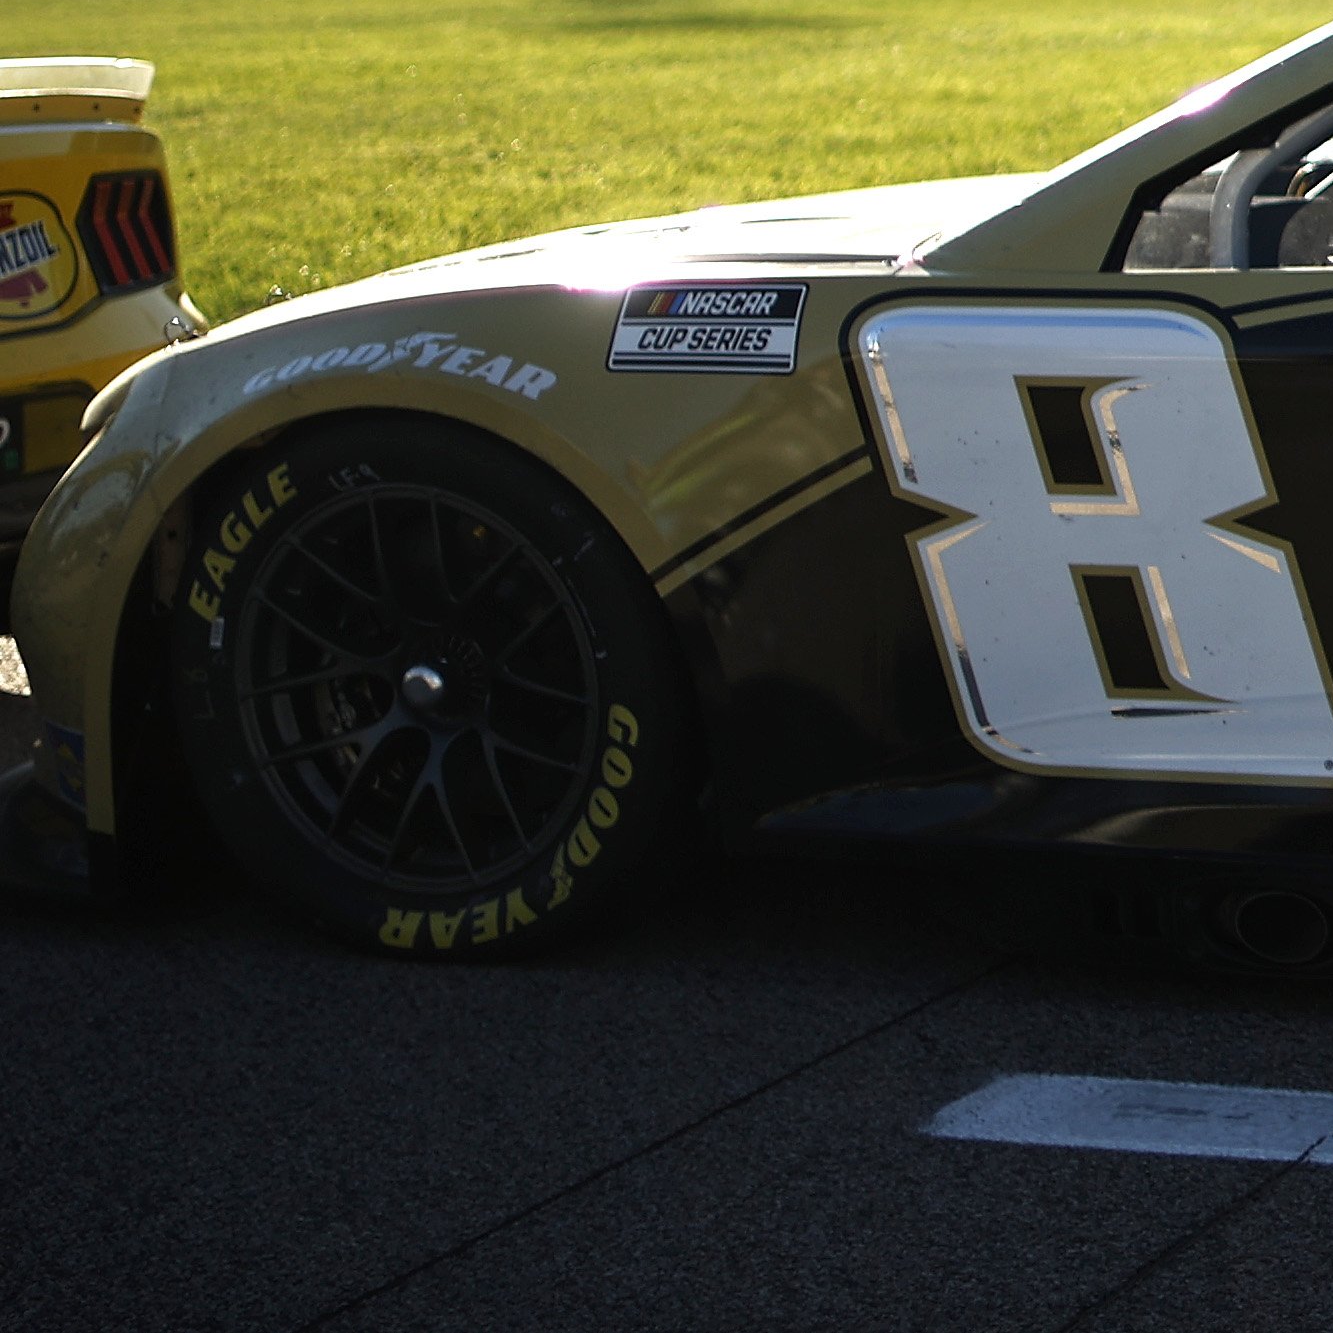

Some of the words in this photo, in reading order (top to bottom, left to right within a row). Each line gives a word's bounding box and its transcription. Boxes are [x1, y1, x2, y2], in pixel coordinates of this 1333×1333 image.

[677, 291, 779, 316] NASCAR
[637, 327, 688, 350] CUP
[688, 328, 772, 351] SERIES
[188, 462, 299, 622] EAGLE
